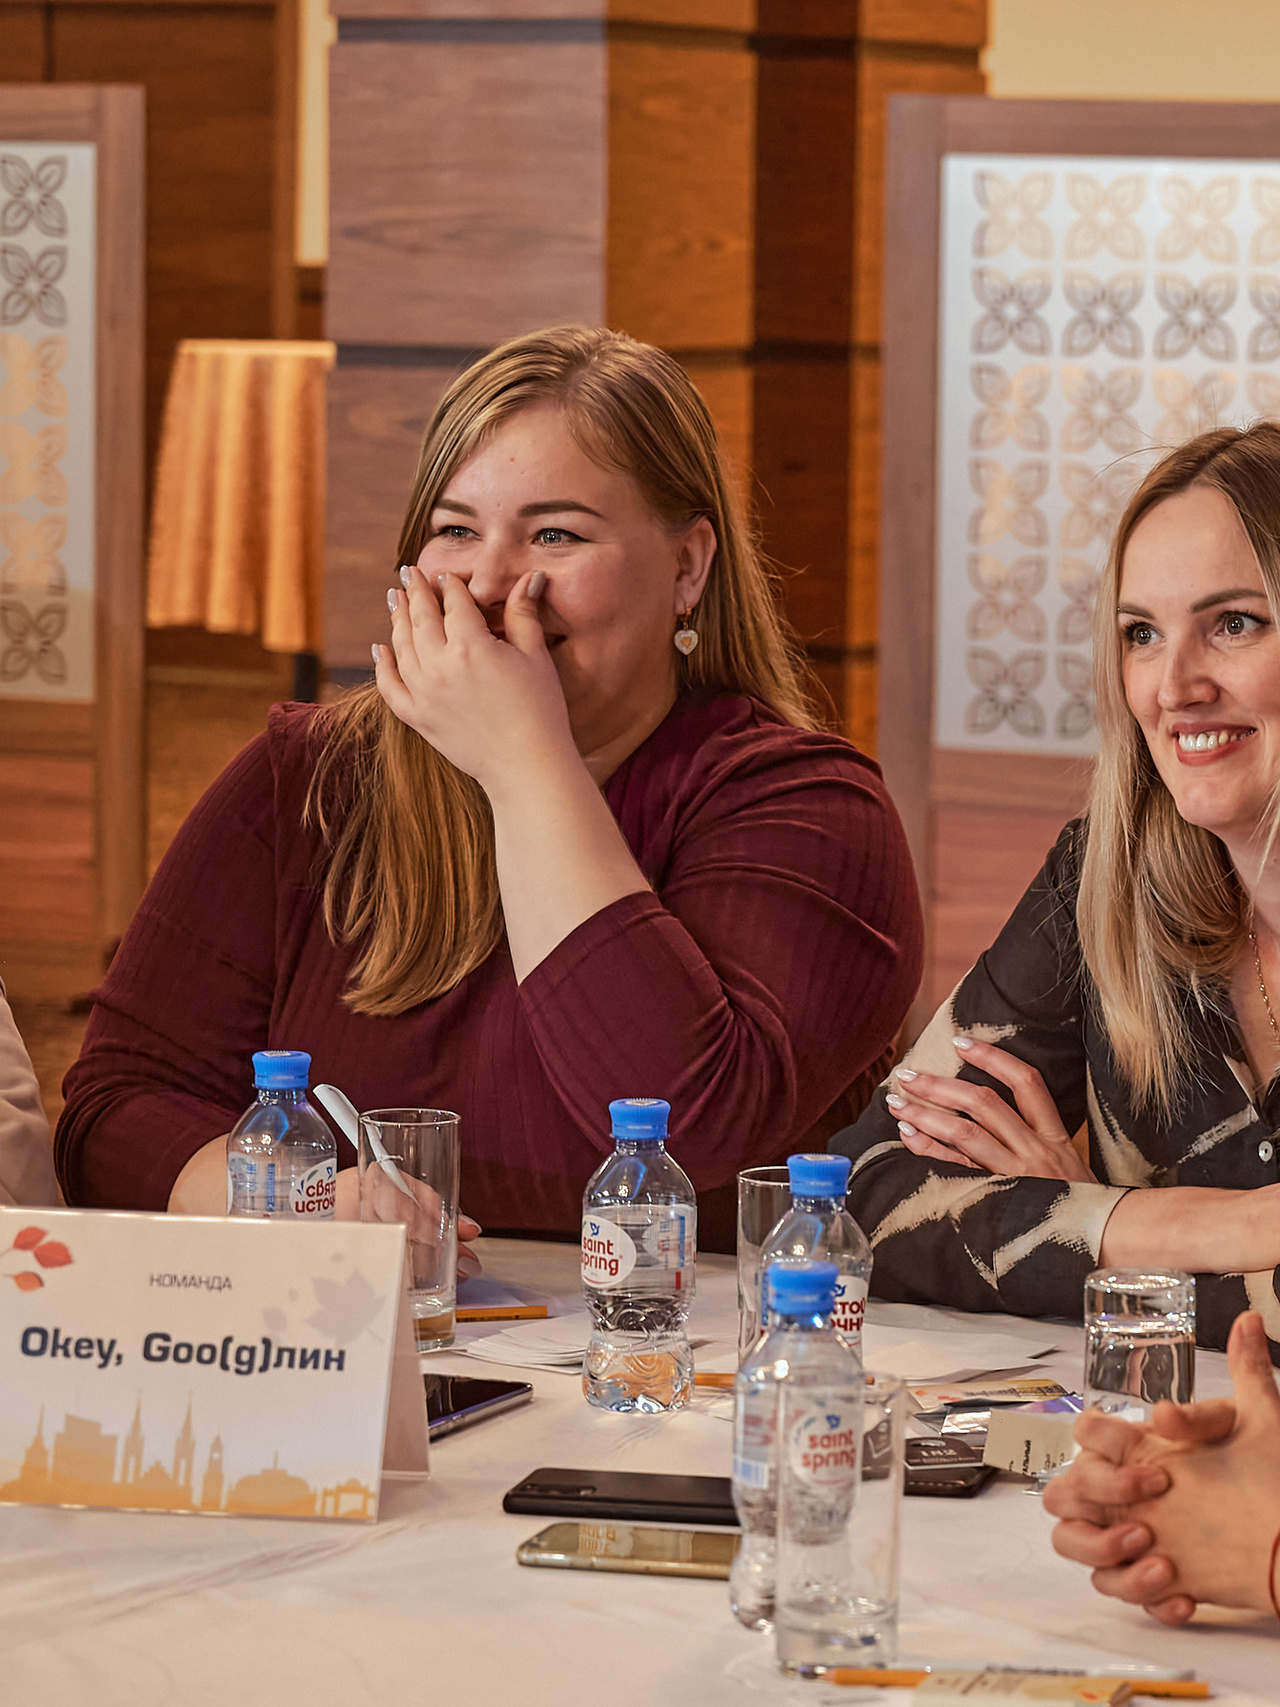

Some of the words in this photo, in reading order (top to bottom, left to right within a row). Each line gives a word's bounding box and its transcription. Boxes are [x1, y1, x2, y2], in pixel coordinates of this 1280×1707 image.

[583, 1236, 614, 1256] saint
[149, 1273, 232, 1293] КОМАНДА
[21, 1326, 123, 1369] Okey,
[143, 1332, 346, 1376] Goo(g)лин
